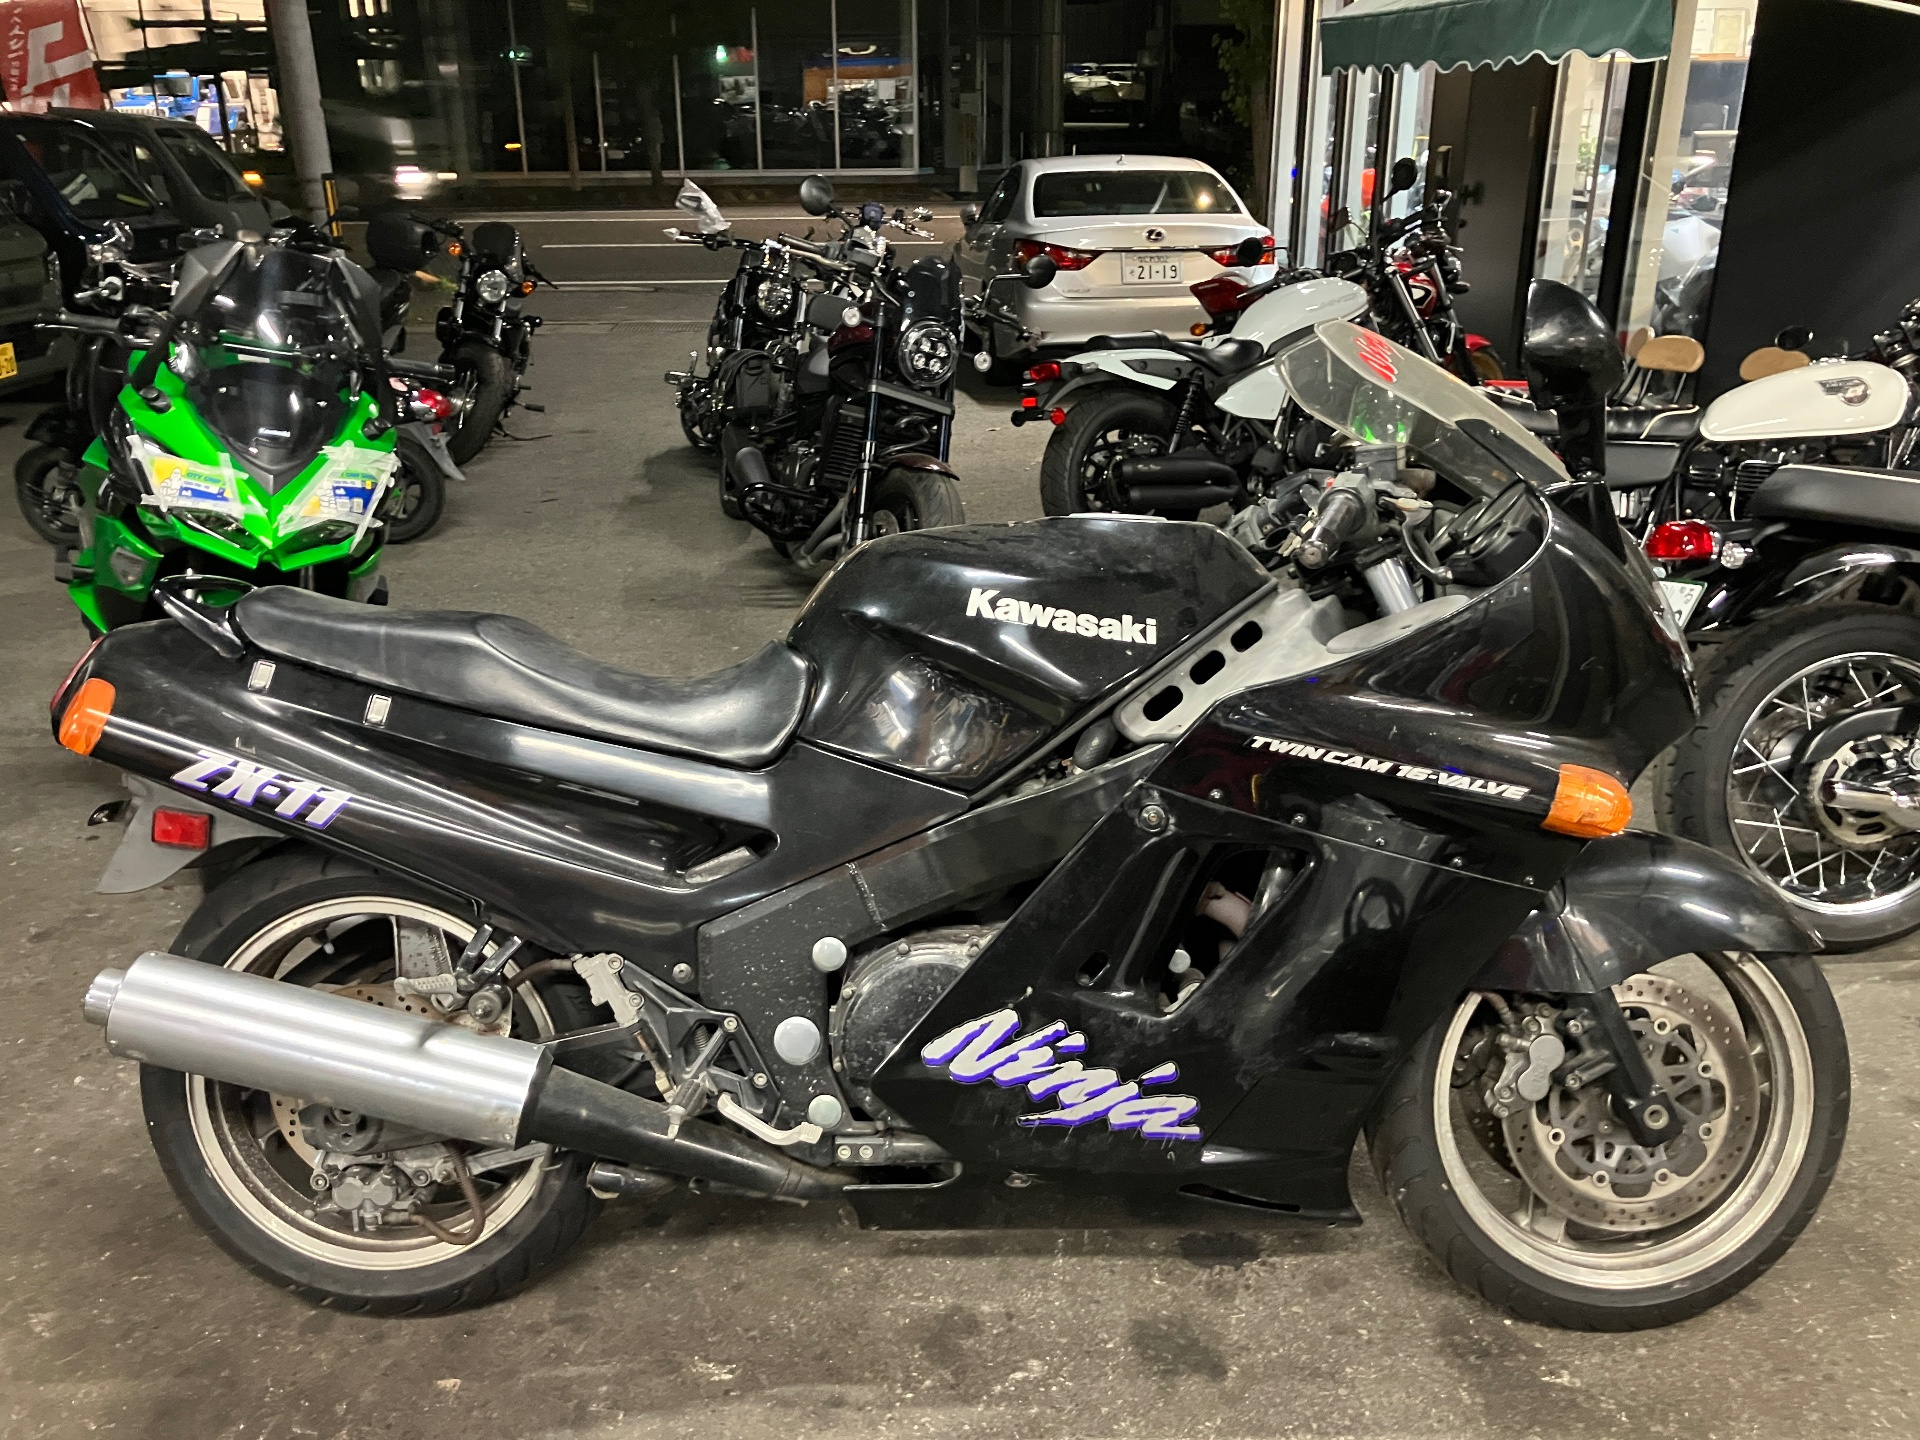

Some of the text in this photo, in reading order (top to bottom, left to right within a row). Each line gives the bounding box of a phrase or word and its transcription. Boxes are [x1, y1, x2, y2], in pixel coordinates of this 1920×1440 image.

[1137, 264, 1178, 280] 21-19
[965, 587, 1157, 645] Kawasaki
[170, 750, 352, 829] ZX-11
[1250, 735, 1531, 800] TWIN CAM 16-VALVE
[921, 1008, 1203, 1140] Ninja
